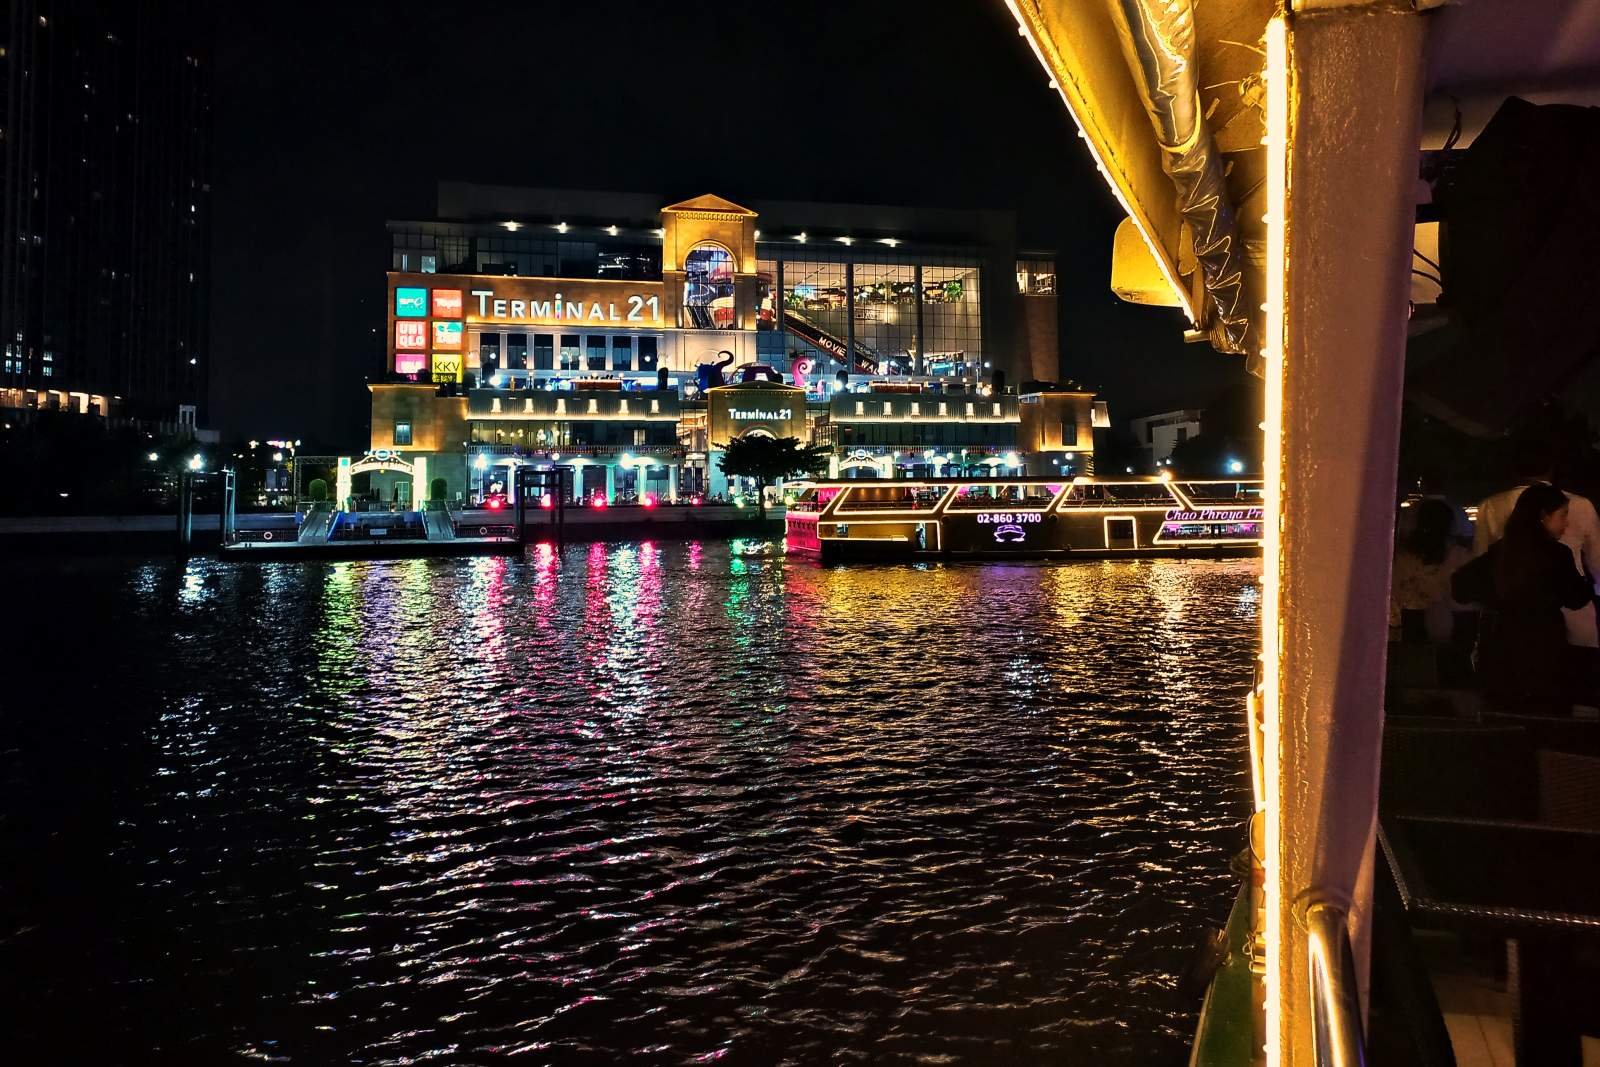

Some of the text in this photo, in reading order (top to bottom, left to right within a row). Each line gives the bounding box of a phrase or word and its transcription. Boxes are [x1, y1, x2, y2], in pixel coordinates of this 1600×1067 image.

[627, 295, 659, 321] 21
[818, 336, 847, 357] MOVIE
[434, 361, 461, 372] KKV
[1015, 513, 1041, 523] 3700
[1165, 509, 1197, 520] Chao
[1200, 508, 1243, 522] Phraya
